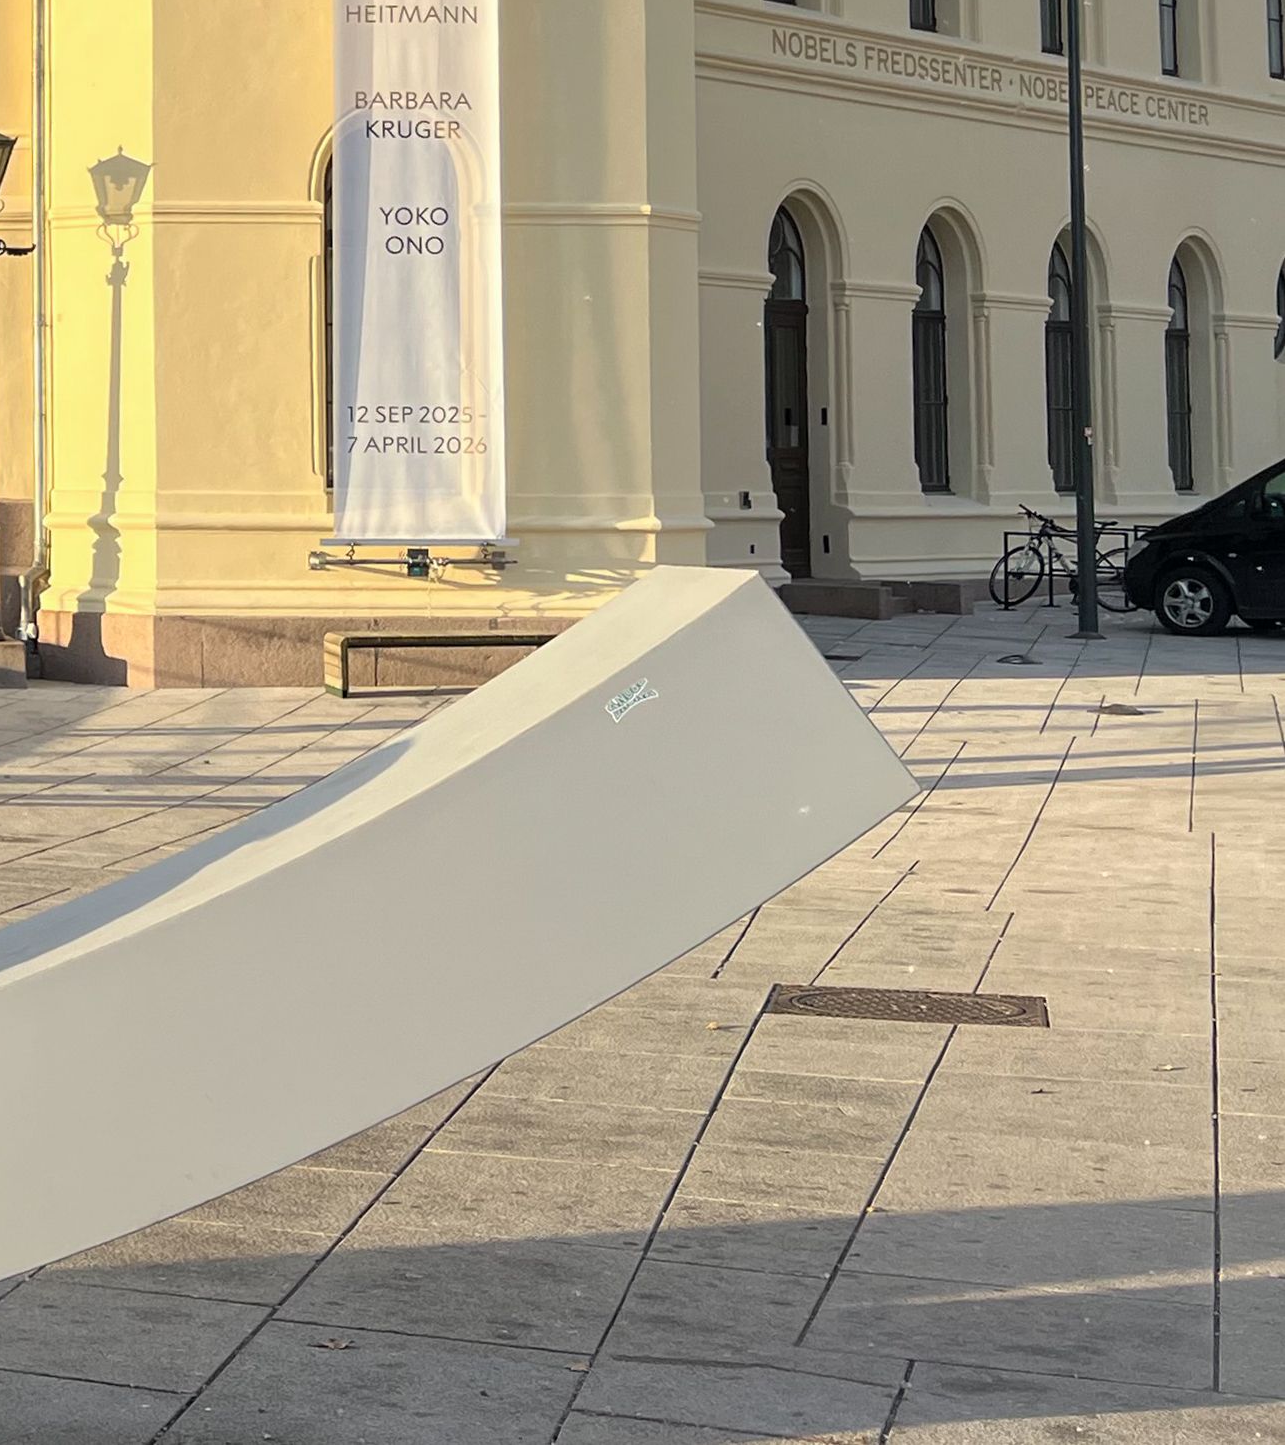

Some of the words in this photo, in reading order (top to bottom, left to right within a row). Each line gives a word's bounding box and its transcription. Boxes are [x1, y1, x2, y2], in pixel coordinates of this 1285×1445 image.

[345, 5, 479, 24] HEITMANN
[771, 28, 858, 68] NOBELS
[863, 46, 1003, 93] FREDSSENTER
[1019, 73, 1069, 103] NOBE
[1083, 85, 1141, 116] PEACE
[1146, 96, 1210, 127] CENTER
[354, 91, 473, 110] BARBARA
[365, 120, 462, 139] KRUGER
[380, 207, 449, 226] YOKO
[385, 236, 444, 255] ONO
[347, 406, 369, 423] 12
[375, 406, 413, 423] SEP
[419, 406, 473, 423] 2025
[347, 436, 358, 453] 7
[363, 436, 428, 454] APRIL
[434, 436, 488, 454] 2026
